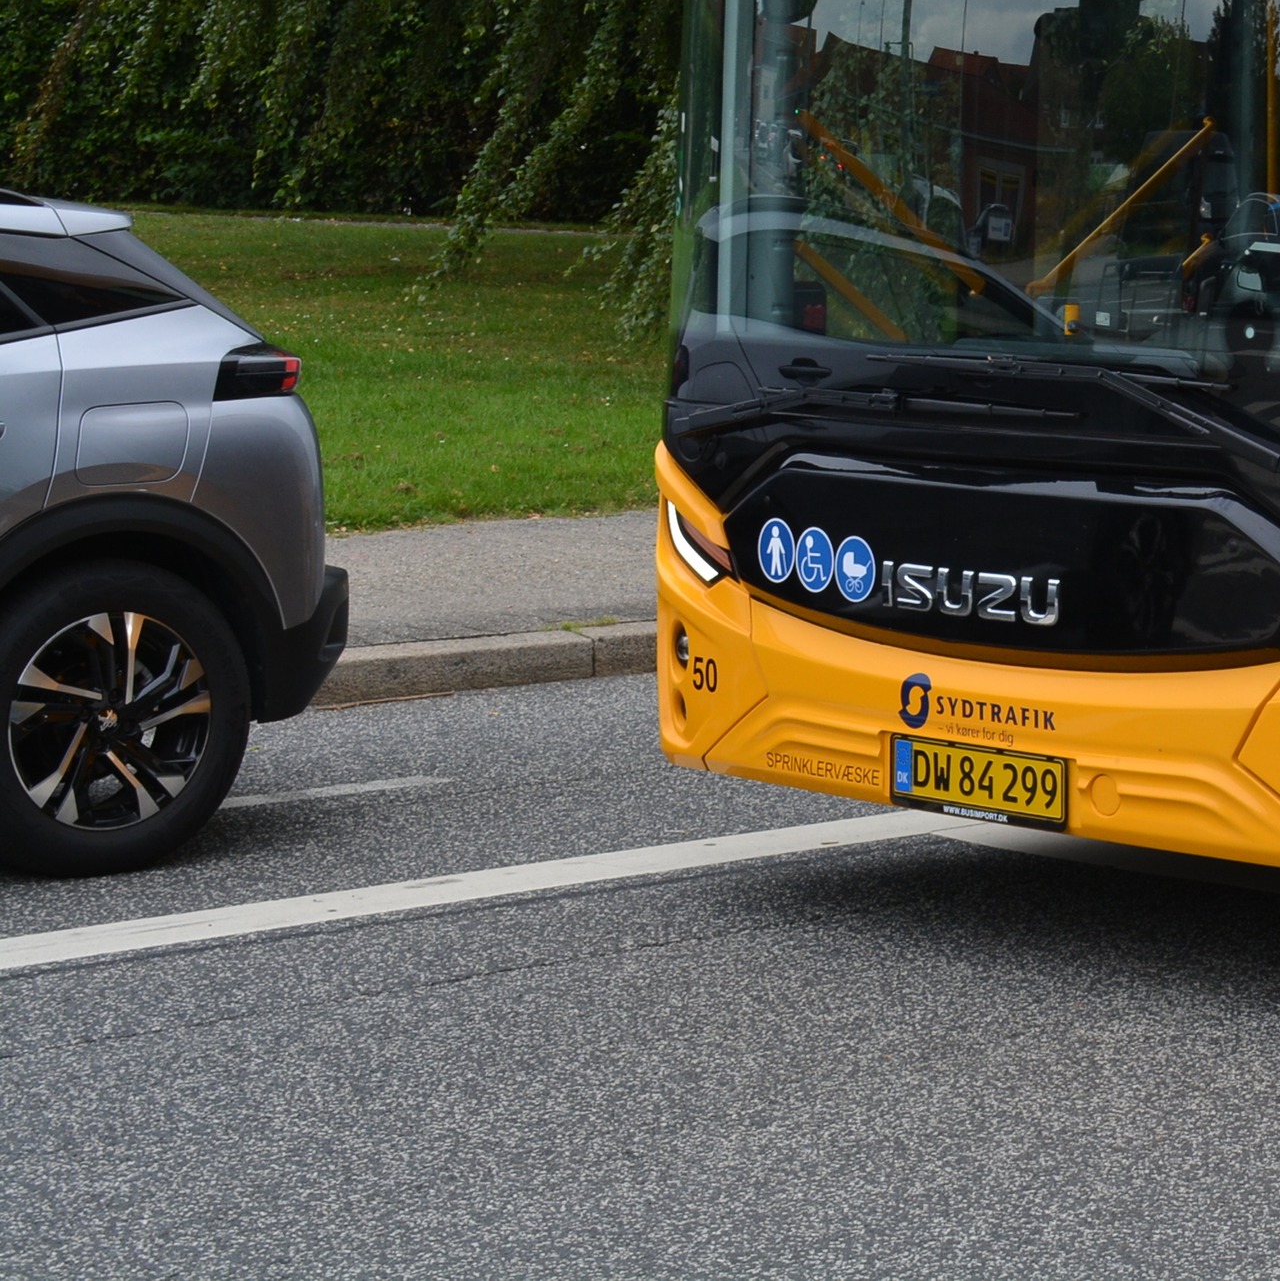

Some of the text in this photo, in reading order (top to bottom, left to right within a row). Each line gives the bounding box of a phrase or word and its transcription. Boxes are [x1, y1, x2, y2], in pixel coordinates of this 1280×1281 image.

[881, 560, 1060, 626] ISUZU
[692, 656, 718, 693] 50
[936, 695, 1056, 731] SYDTRAFIK
[946, 722, 954, 735] vi
[956, 723, 980, 739] kører
[982, 726, 996, 741] for
[999, 728, 1014, 747] dig
[766, 751, 880, 786] SPRINKLERVÆSKE
[897, 770, 909, 784] DK
[913, 749, 1058, 810] DW 84 299
[943, 804, 1008, 823] WWW.BUSIMPORT.DK
